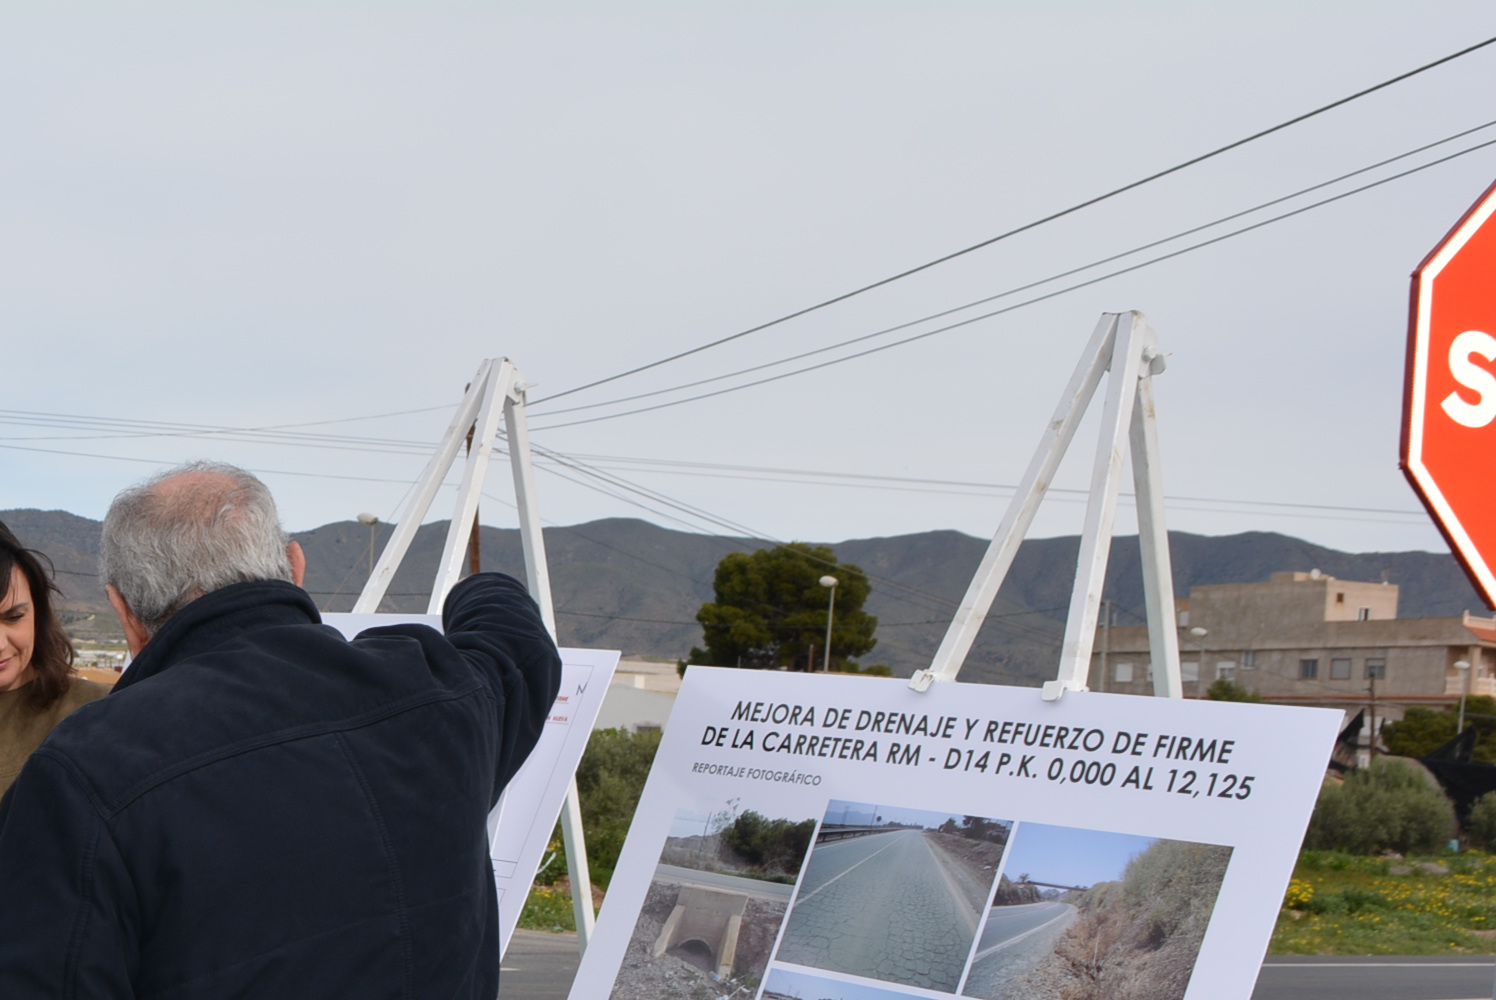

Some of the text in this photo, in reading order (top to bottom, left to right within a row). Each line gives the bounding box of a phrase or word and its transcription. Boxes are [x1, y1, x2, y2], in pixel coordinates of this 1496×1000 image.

[701, 725, 729, 748] DE
[731, 728, 755, 750] LA
[762, 731, 878, 762] CARRETERA
[885, 743, 921, 766] RM
[943, 748, 991, 773] D14
[995, 752, 1038, 779] P.K.
[1047, 757, 1116, 786] 0,000
[1120, 765, 1154, 790] AL
[1166, 769, 1255, 800] 12,125
[730, 700, 1235, 764] MEJORA DE DRENAJE Y REFUERZO DE FIRME
[692, 762, 822, 786] REPORTAJE FOTOGRÁFICO
